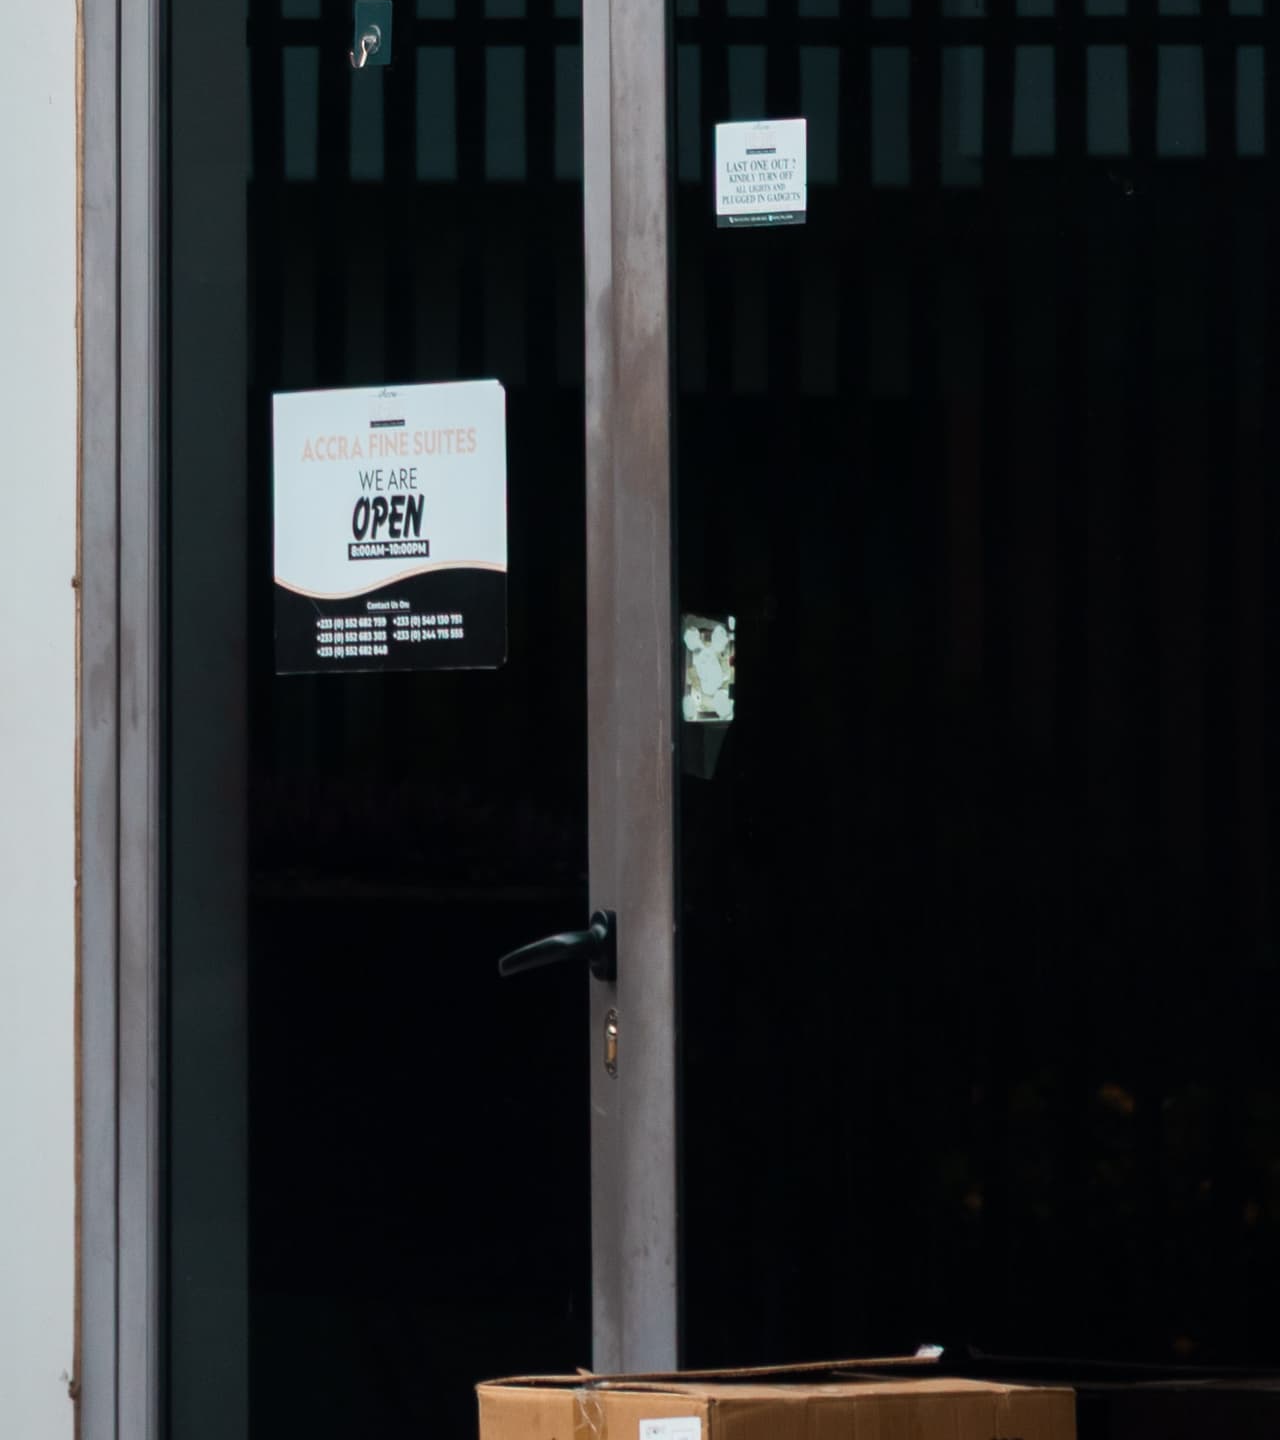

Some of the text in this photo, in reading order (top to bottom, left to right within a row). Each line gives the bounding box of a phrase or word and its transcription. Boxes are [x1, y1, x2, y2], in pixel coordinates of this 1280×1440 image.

[726, 161, 747, 174] LAST
[750, 160, 769, 172] ONE
[771, 158, 789, 170] OUT
[729, 172, 756, 184] KINDLY
[759, 171, 778, 182] TURN
[722, 191, 801, 206] PLUGGED IN GADGETS
[302, 428, 478, 462] ACCRA FINE SUITES
[359, 467, 418, 491] WE ARE
[352, 493, 425, 542] OPEN
[367, 600, 390, 610] Contact
[390, 600, 398, 610] Us
[393, 616, 409, 626] +233
[393, 630, 409, 640] +233
